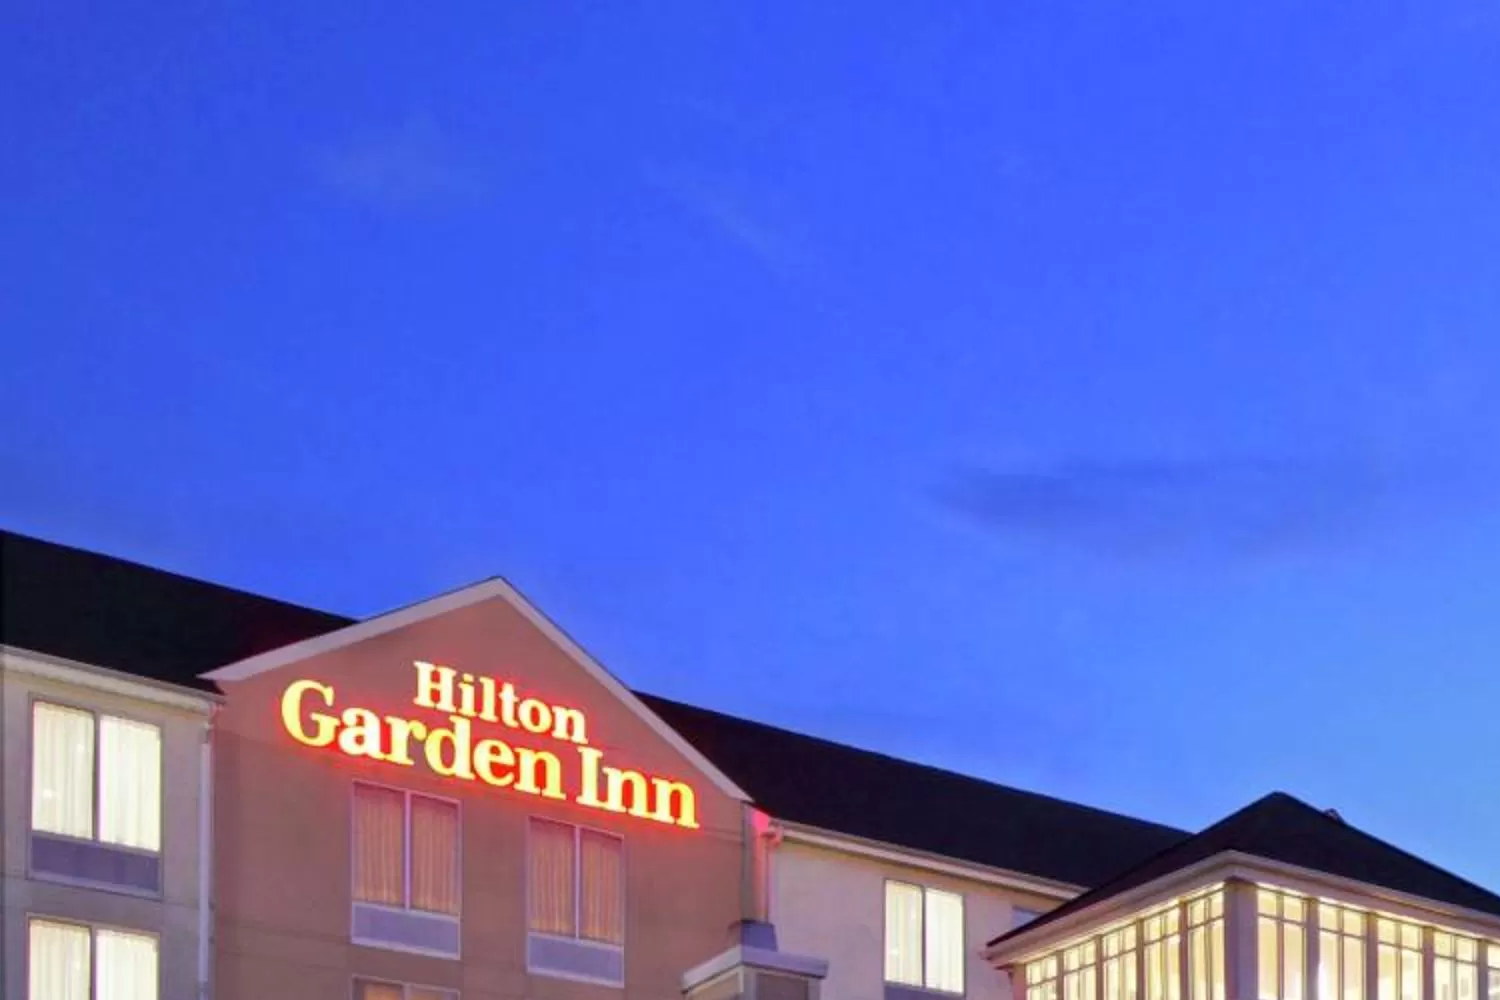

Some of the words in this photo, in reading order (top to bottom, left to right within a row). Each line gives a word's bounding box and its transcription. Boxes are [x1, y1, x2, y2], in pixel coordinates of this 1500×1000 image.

[281, 679, 566, 799] Garden
[576, 746, 700, 829] Inn
[414, 661, 588, 744] Hilton
